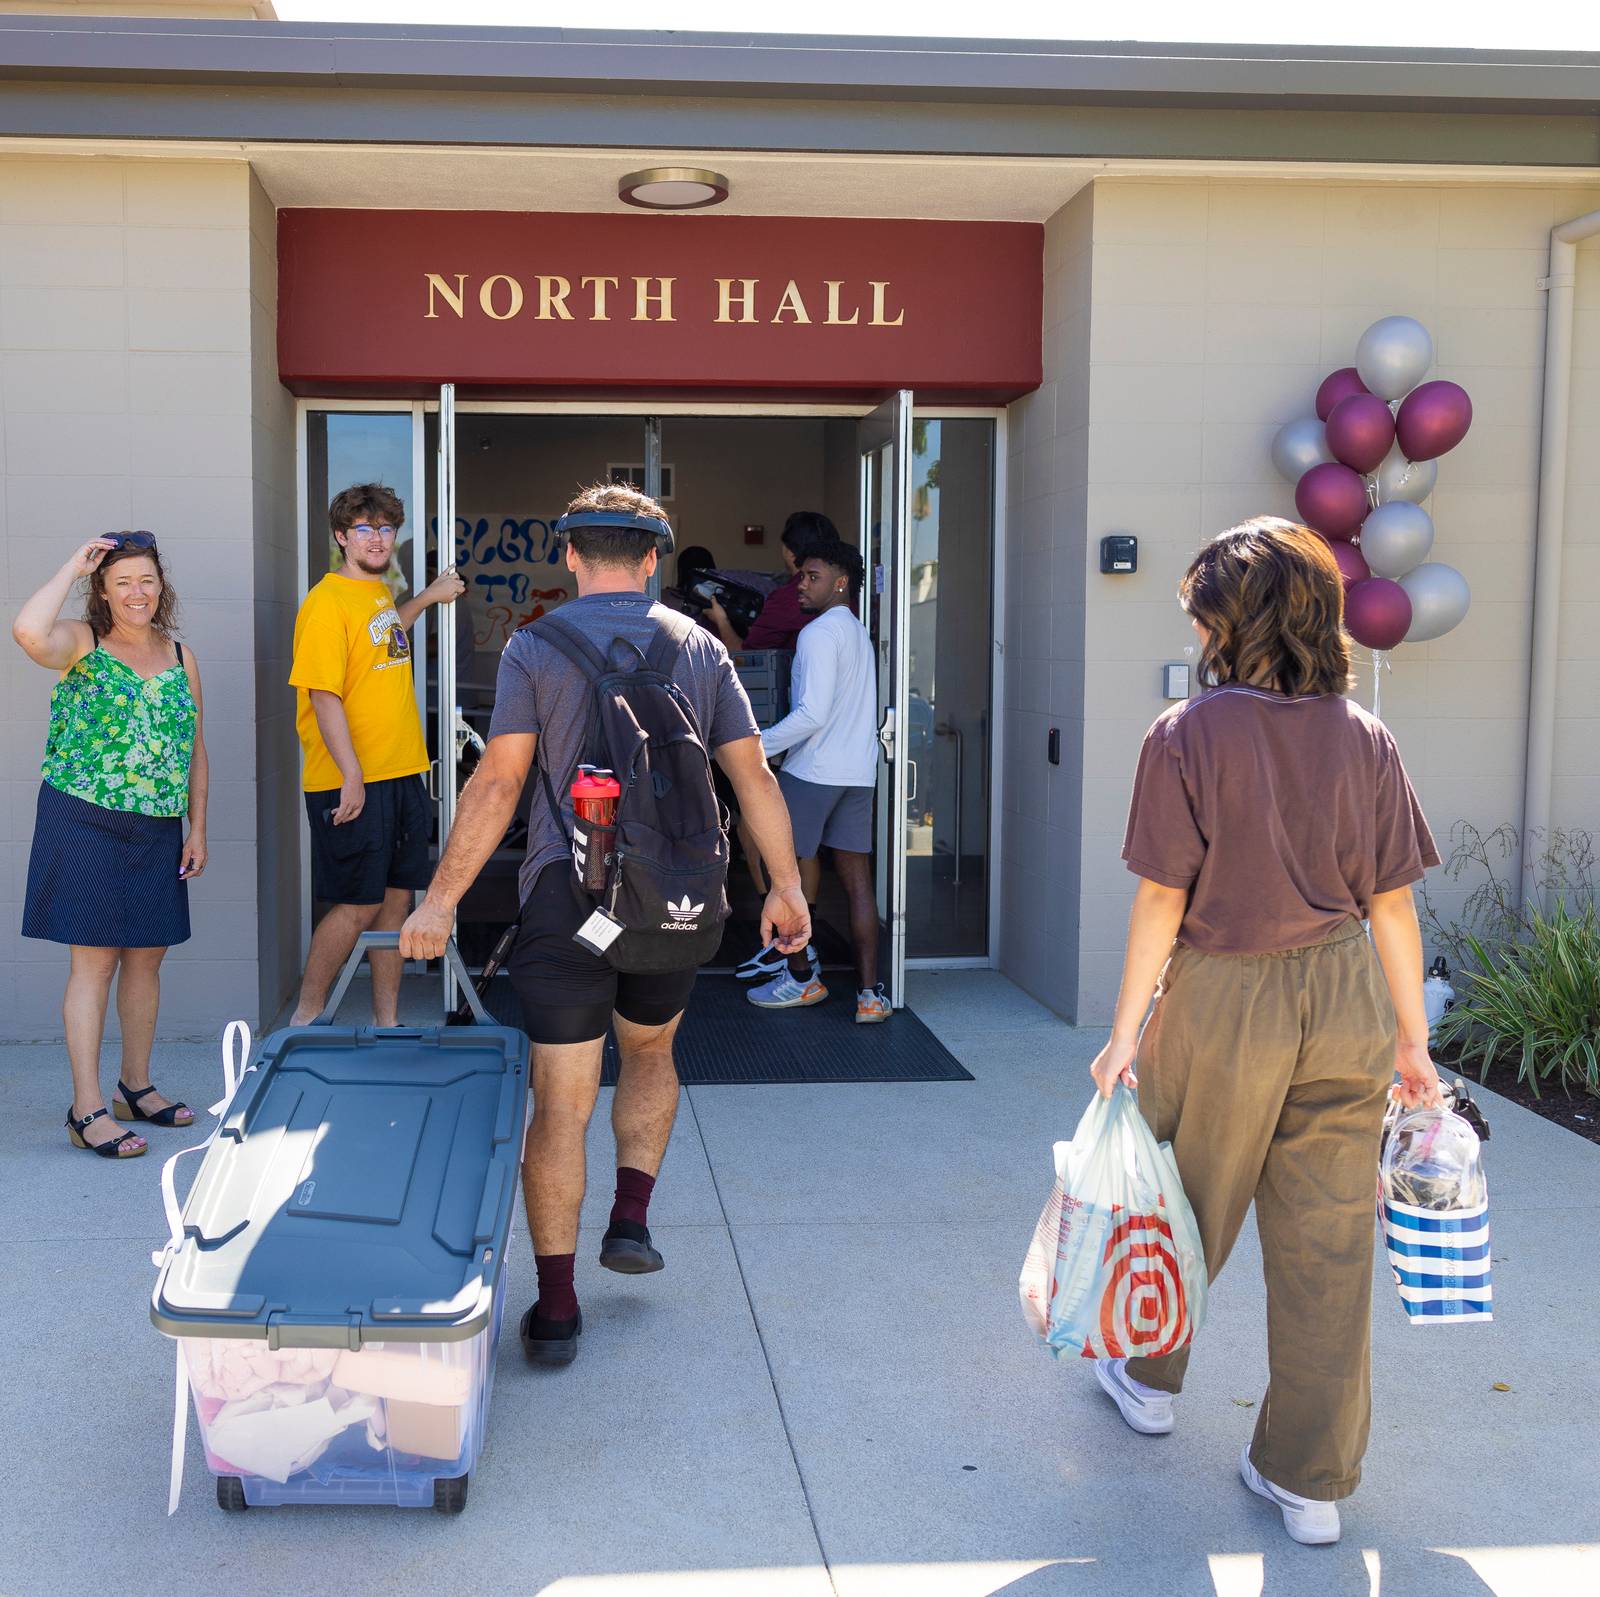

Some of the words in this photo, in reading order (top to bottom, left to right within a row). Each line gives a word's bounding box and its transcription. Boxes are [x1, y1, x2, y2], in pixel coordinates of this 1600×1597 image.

[424, 274, 677, 321] NORTH
[714, 279, 904, 325] HALL
[432, 517, 560, 567] ELCO
[475, 573, 530, 604] TO
[661, 922, 698, 930] adidas
